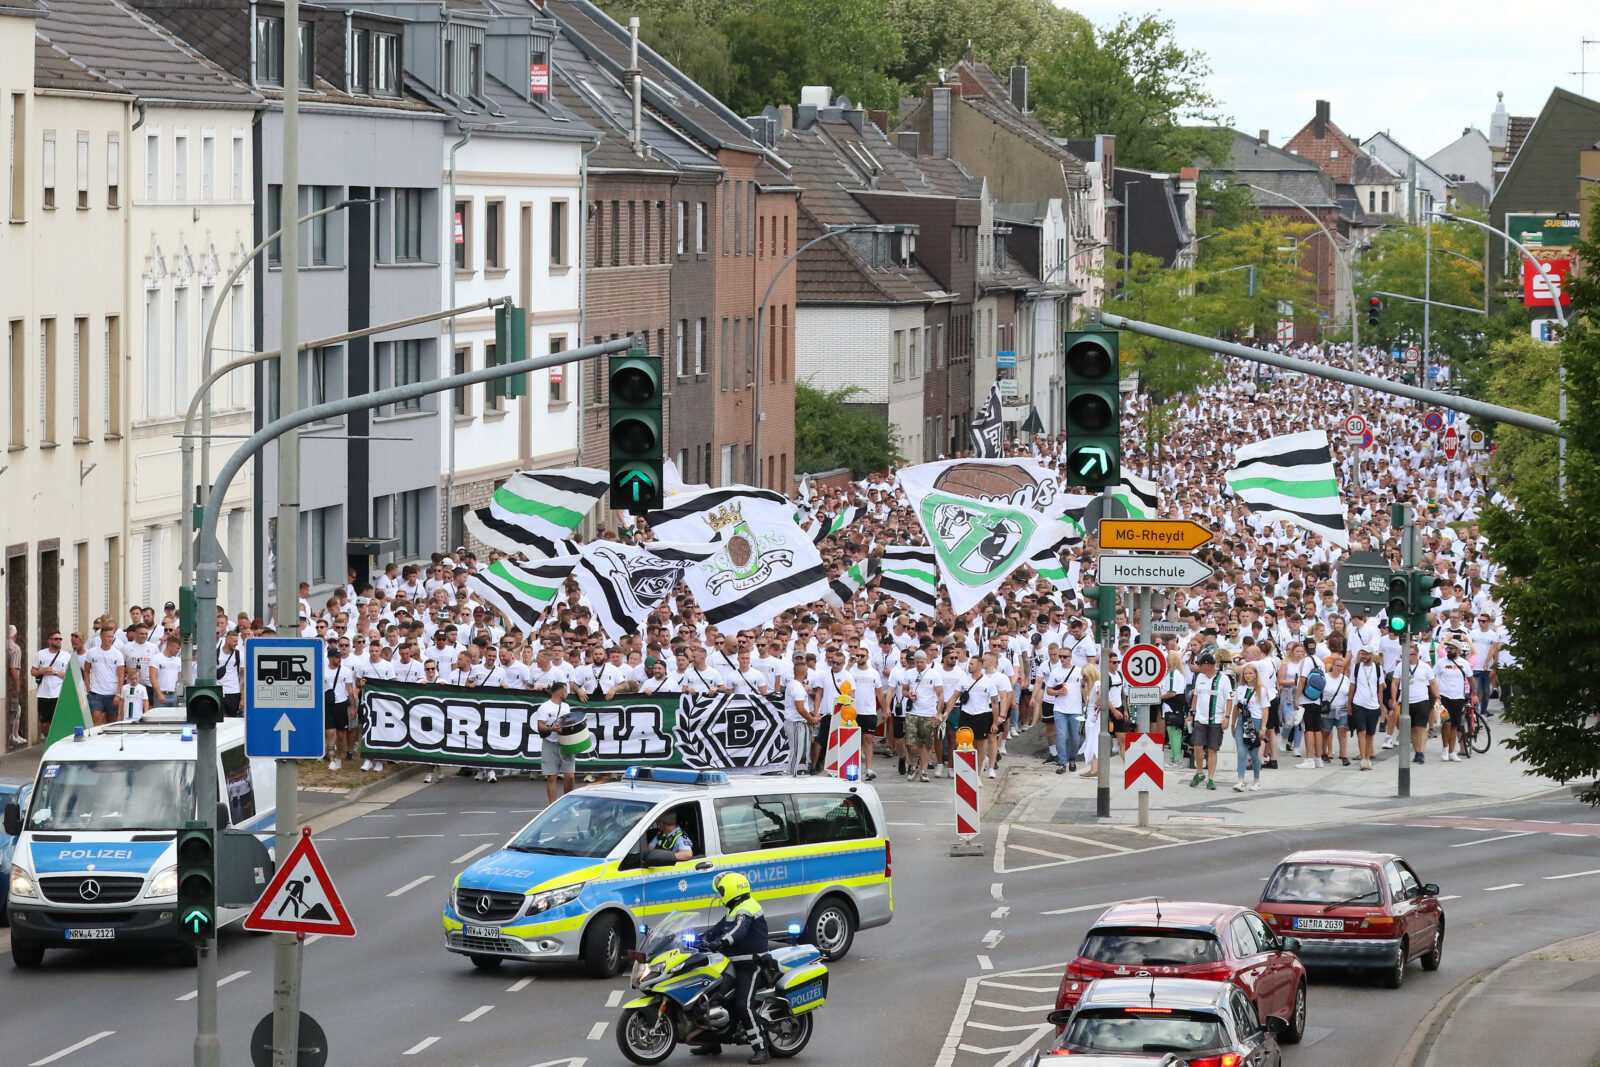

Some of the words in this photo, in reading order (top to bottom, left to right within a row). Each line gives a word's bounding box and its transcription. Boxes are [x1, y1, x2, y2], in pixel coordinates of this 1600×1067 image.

[1544, 219, 1580, 228] SUBWAY
[1408, 349, 1417, 359] 30
[1350, 421, 1361, 431] 30
[1445, 437, 1457, 450] STOP
[1116, 529, 1184, 543] MG-Rheydt
[1114, 565, 1185, 577] Hochschule
[1131, 656, 1157, 676] 30
[59, 849, 133, 860] POLIZEI
[480, 867, 534, 878] POLIZEI
[467, 926, 476, 934] NRW
[1298, 919, 1308, 928] SU
[1313, 920, 1323, 929] RA
[1325, 921, 1343, 930] 2039
[69, 929, 84, 938] NRW
[791, 986, 822, 1006] POLIZEI
